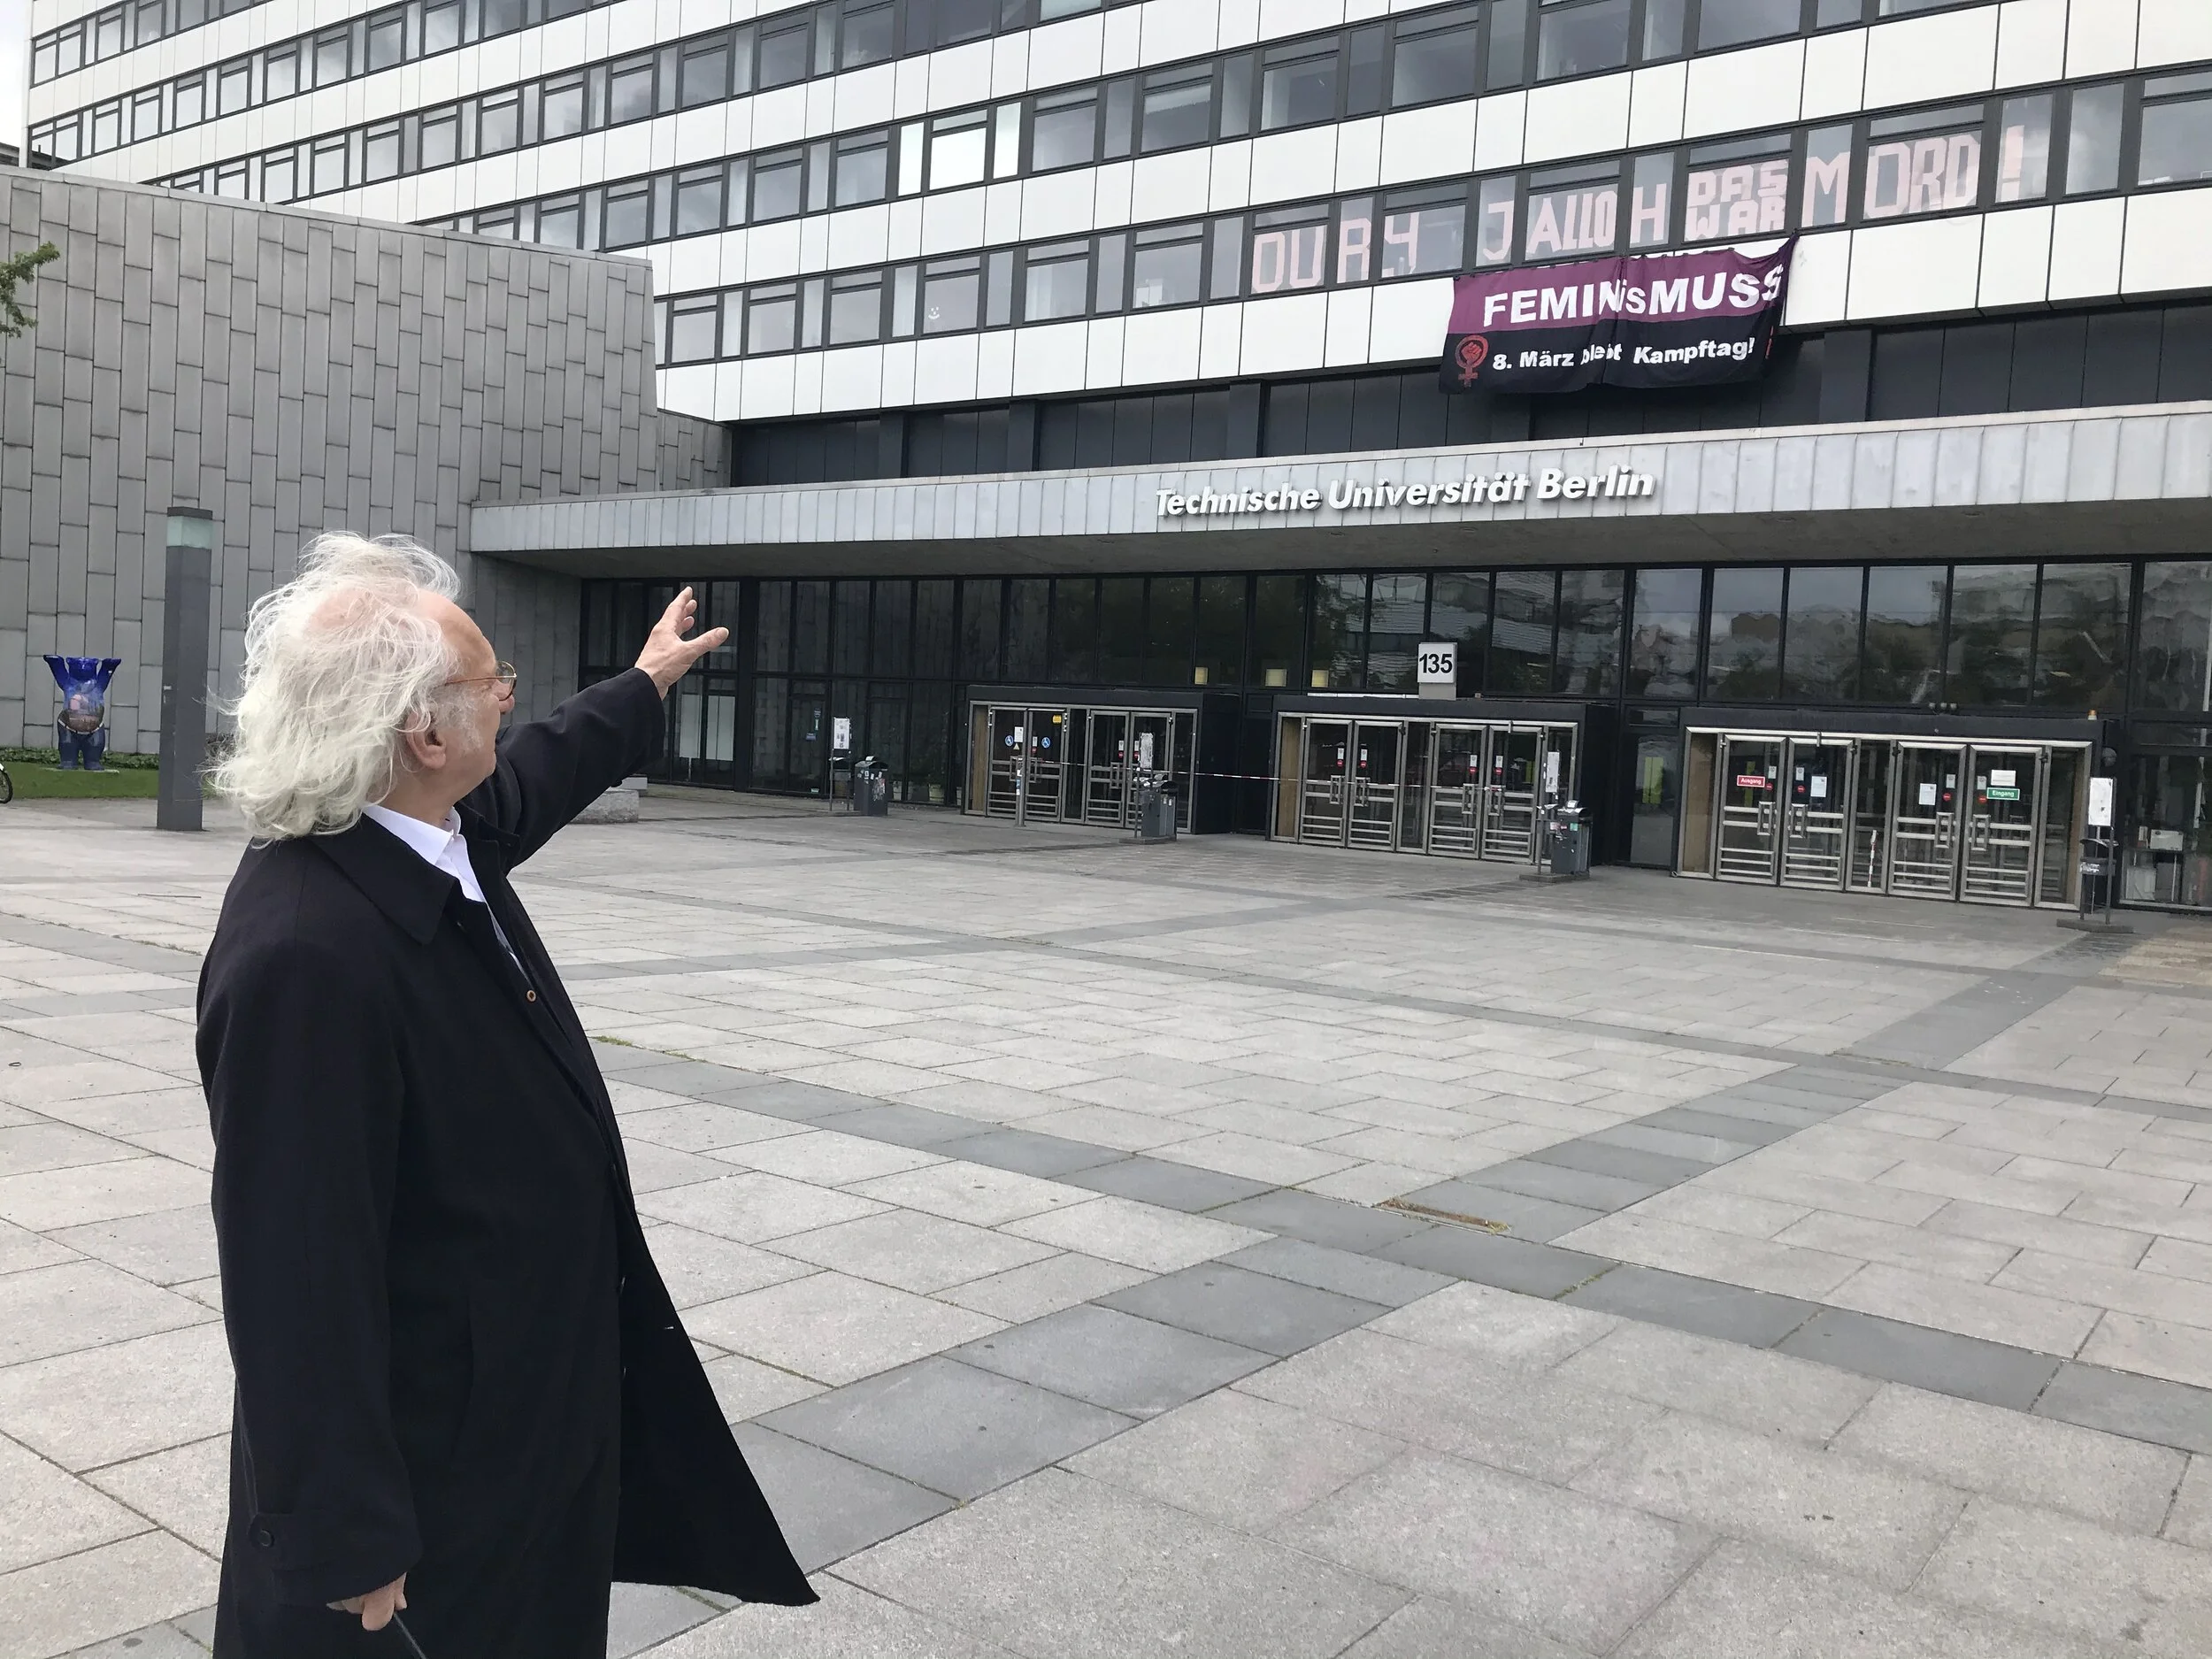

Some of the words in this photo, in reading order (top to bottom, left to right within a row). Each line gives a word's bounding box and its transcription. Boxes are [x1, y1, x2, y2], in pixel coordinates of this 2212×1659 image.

[1687, 159, 1788, 207] DAS
[1251, 211, 1419, 293] OURY
[1482, 182, 1667, 261] JALLOH
[1684, 196, 1786, 242] WAR
[1493, 353, 1512, 371] 8.
[1519, 350, 1574, 369] März
[1633, 337, 1755, 365] Kampftag!
[1156, 482, 1323, 517] Technische
[1328, 472, 1531, 510] Universität
[1536, 465, 1657, 501] Berlin
[1419, 653, 1453, 674] 135
